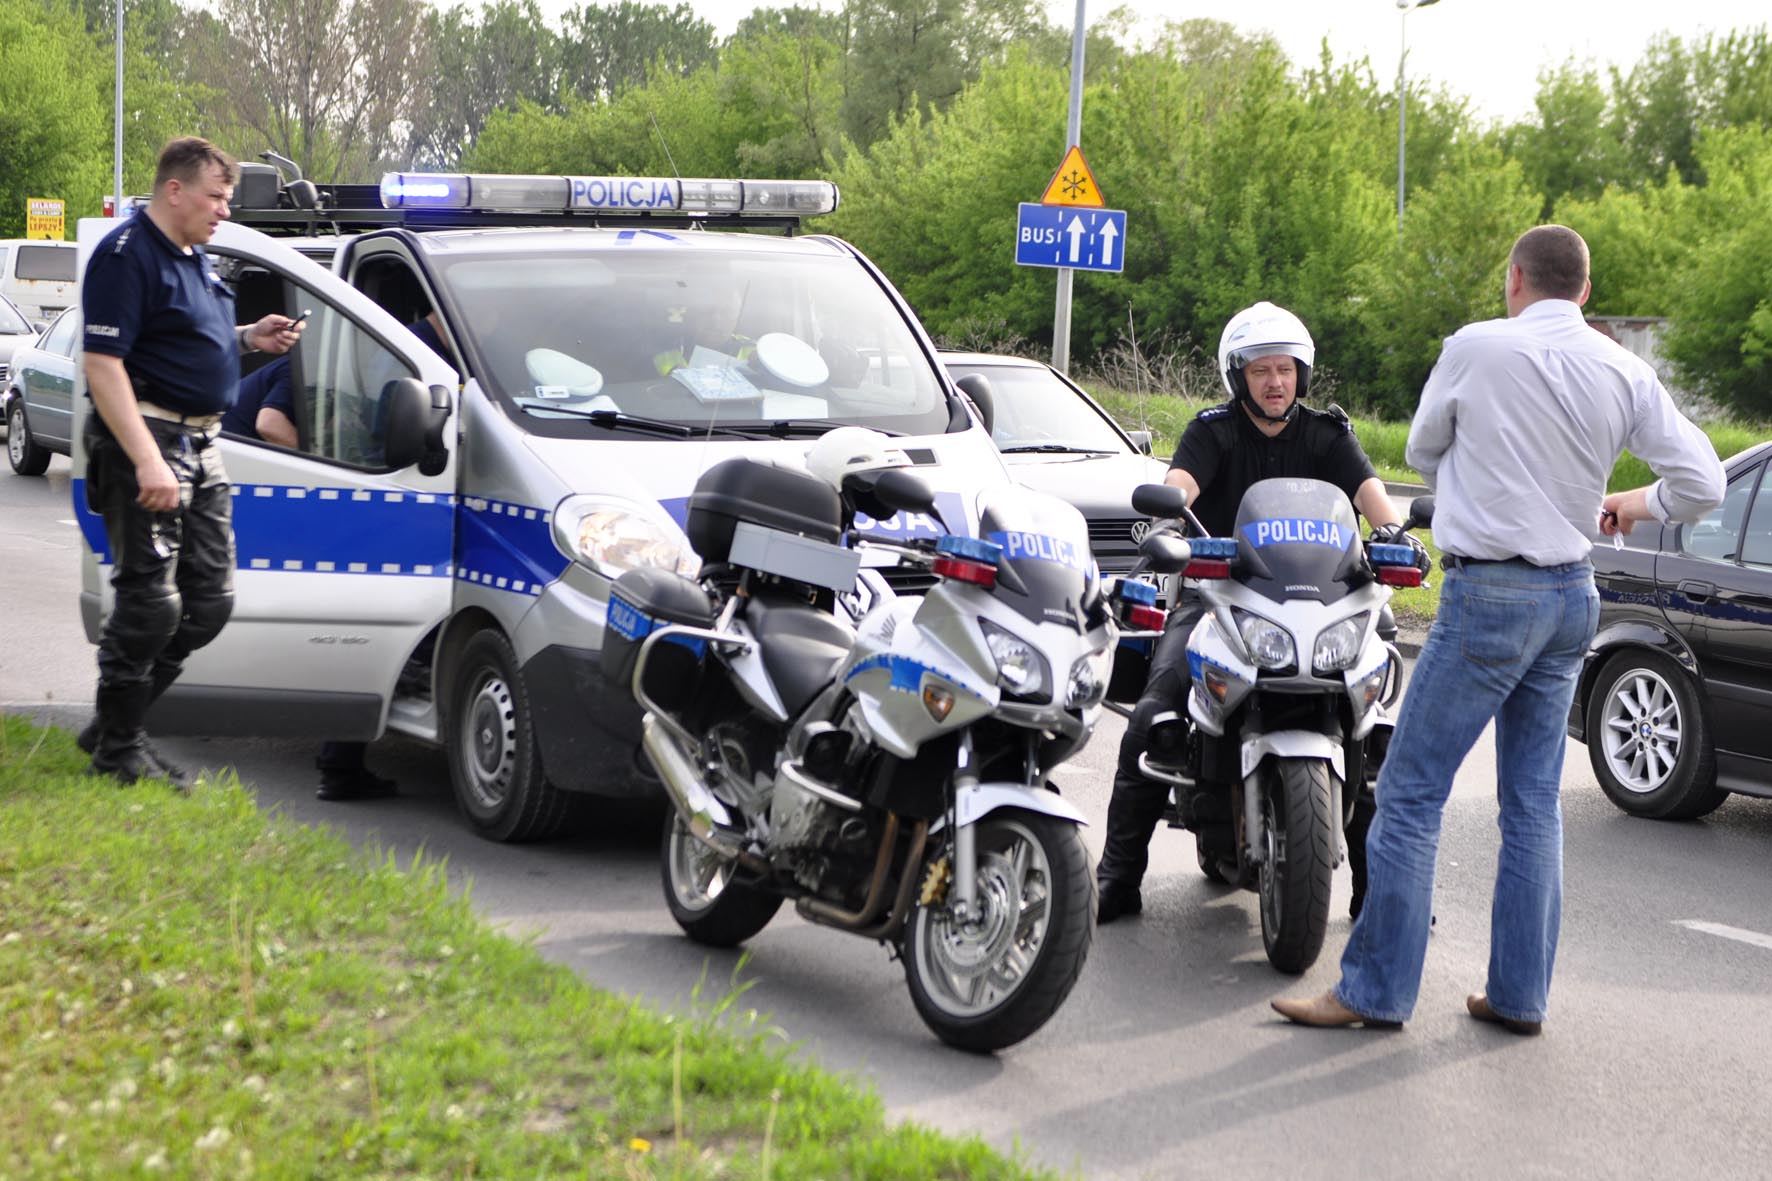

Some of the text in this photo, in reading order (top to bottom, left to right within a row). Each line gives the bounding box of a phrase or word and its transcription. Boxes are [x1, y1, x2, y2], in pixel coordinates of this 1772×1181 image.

[574, 180, 674, 207] POLICJA
[1021, 227, 1055, 244] BUS
[1257, 520, 1342, 548] POLICJA
[1007, 532, 1085, 571] POLICJ
[1285, 584, 1320, 592] HONDA
